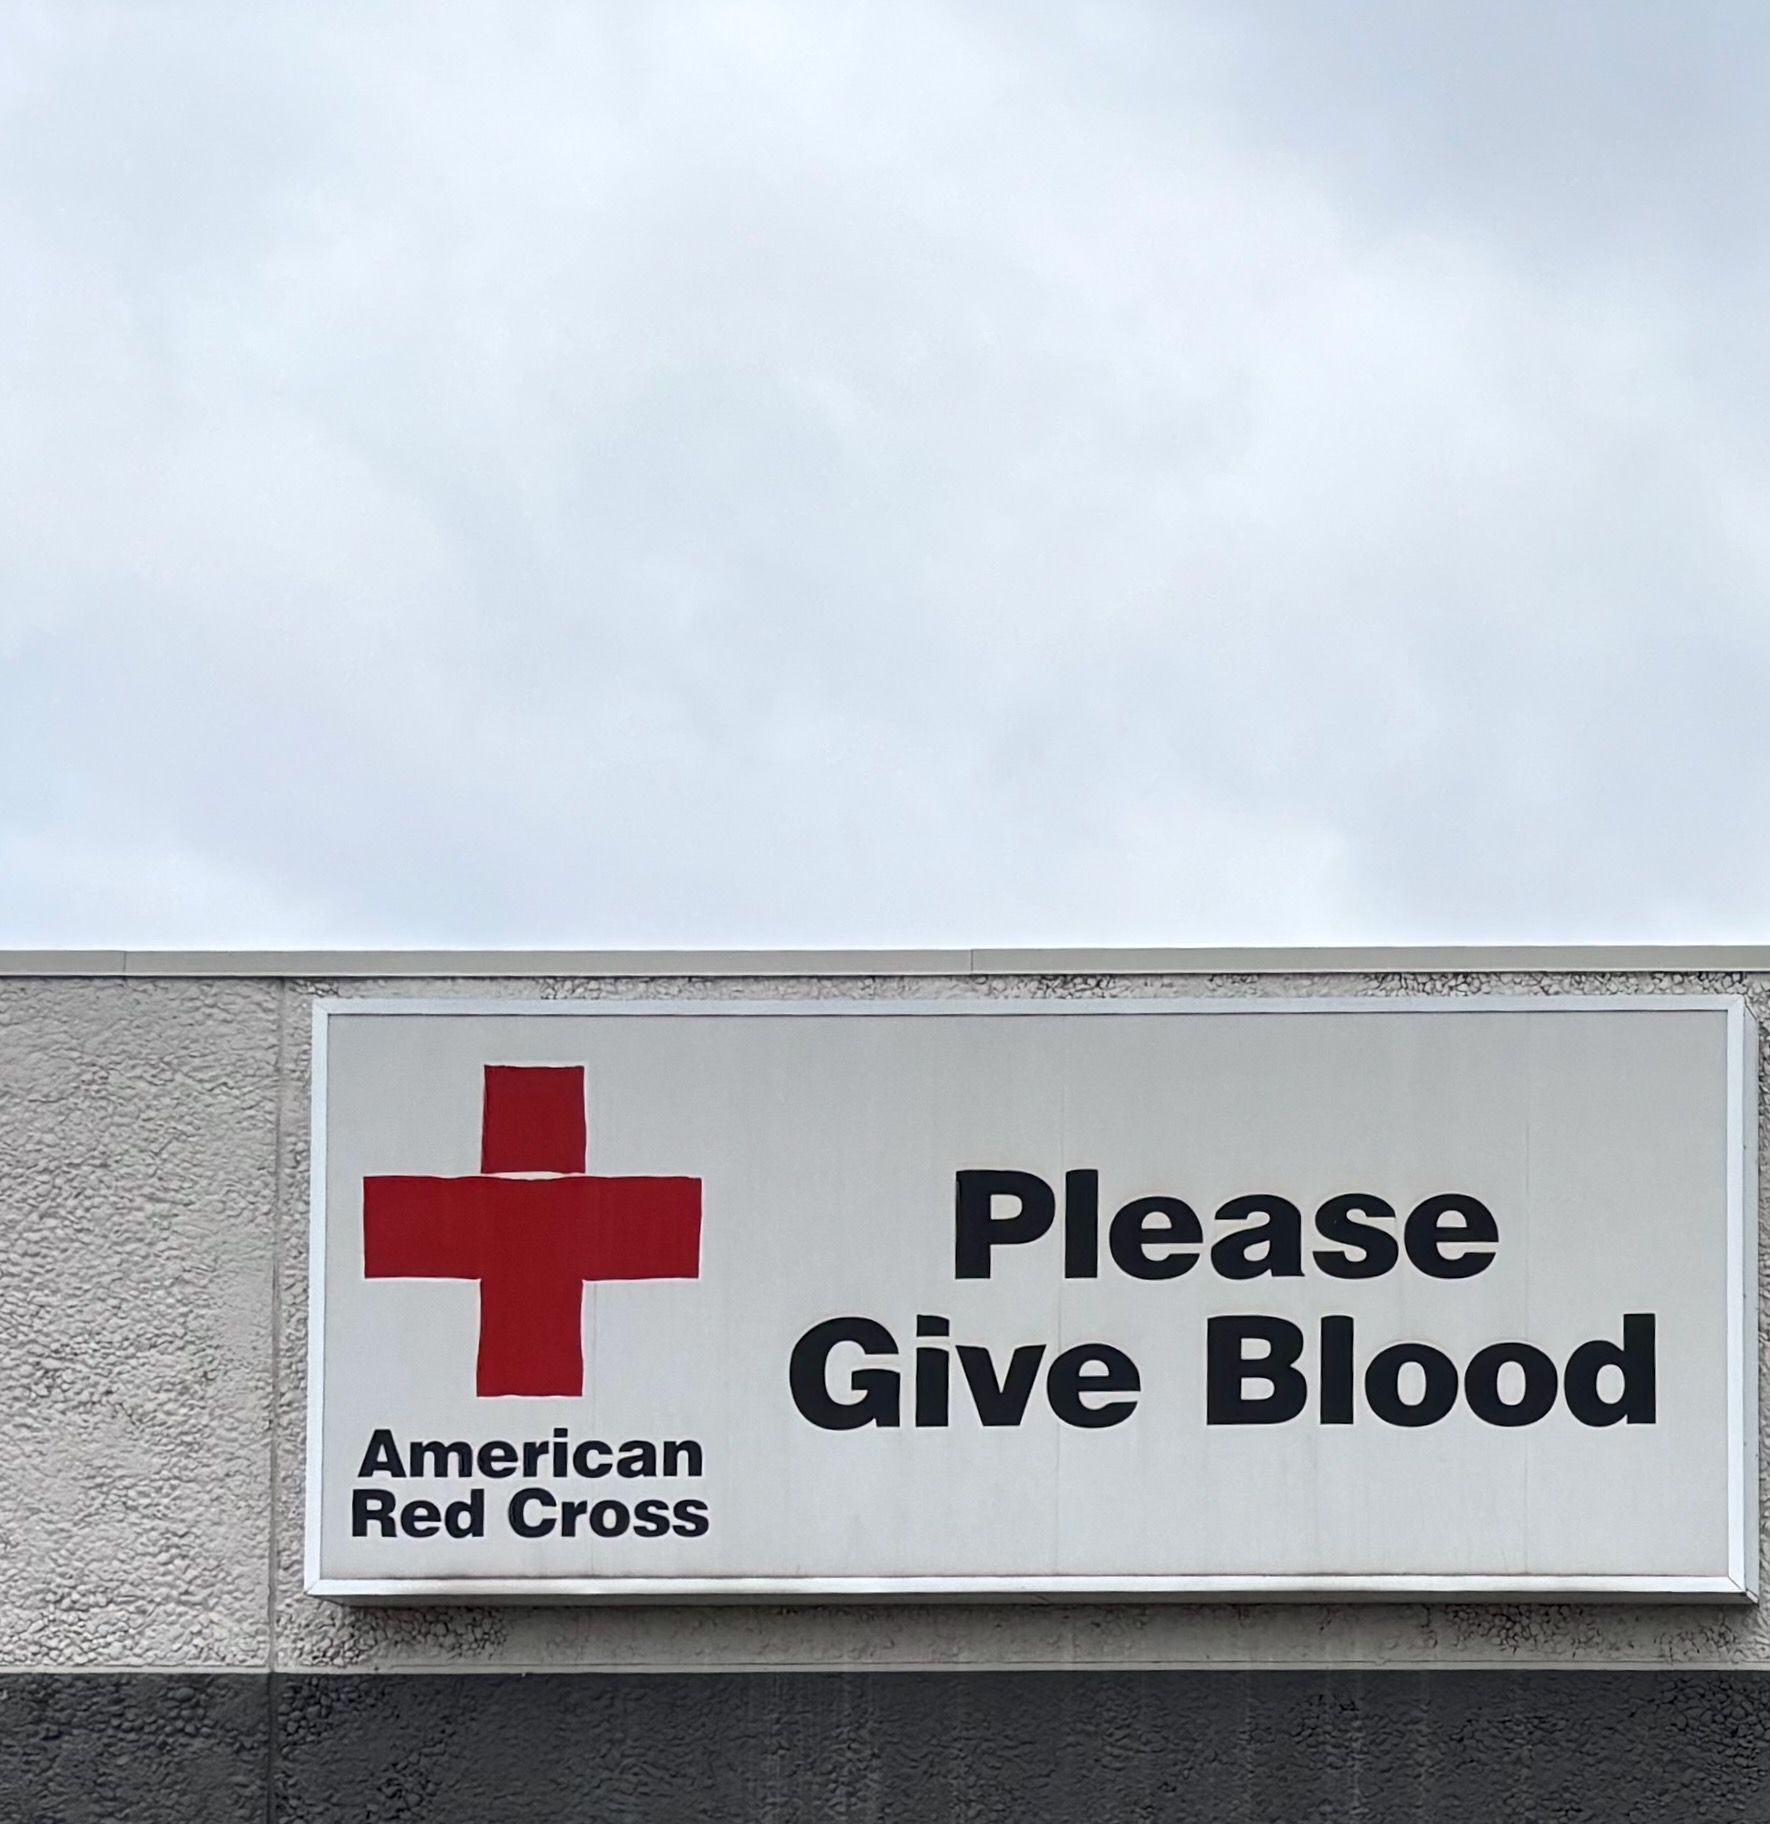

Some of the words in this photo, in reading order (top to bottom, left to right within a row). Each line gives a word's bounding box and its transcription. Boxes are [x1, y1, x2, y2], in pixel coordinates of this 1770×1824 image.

[952, 1169, 1500, 1281] Please
[788, 1314, 1142, 1430] Give
[1205, 1312, 1659, 1429] Blood
[358, 1428, 704, 1481] American
[349, 1488, 485, 1540] Red
[506, 1488, 710, 1540] Cross
